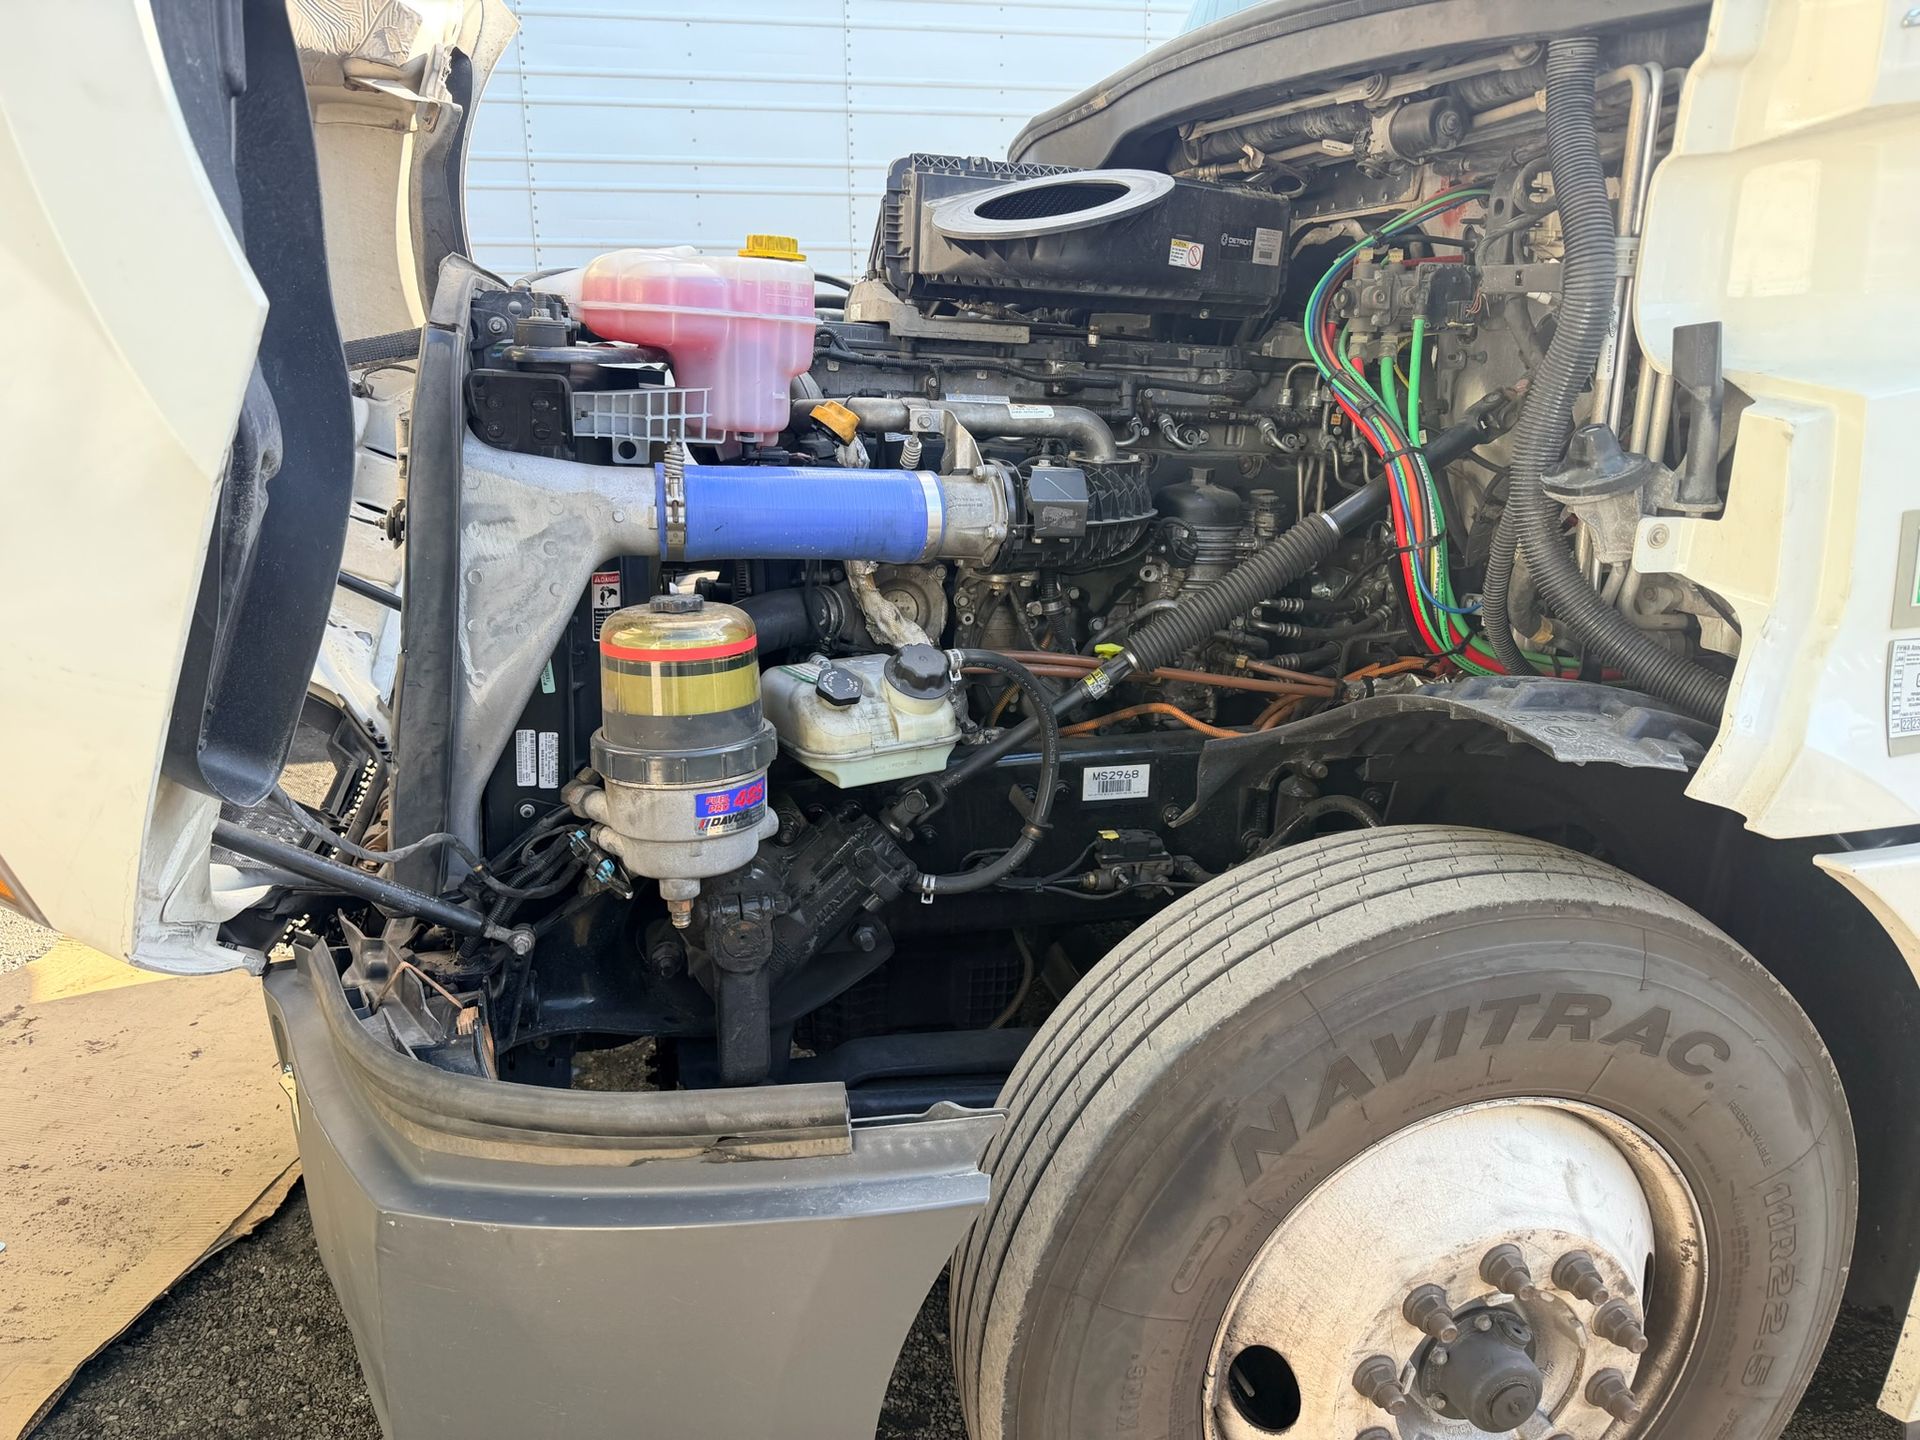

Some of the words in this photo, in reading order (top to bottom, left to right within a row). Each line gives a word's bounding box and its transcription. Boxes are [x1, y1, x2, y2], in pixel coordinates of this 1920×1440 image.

[1228, 237, 1253, 246] DETROIT
[1902, 719, 1911, 730] 22
[1093, 770, 1139, 781] MS2968
[1231, 992, 1731, 1187] NAVITRAC
[1728, 1099, 1772, 1168] REGROOVABLE
[1741, 1182, 1797, 1388] 11R22.5
